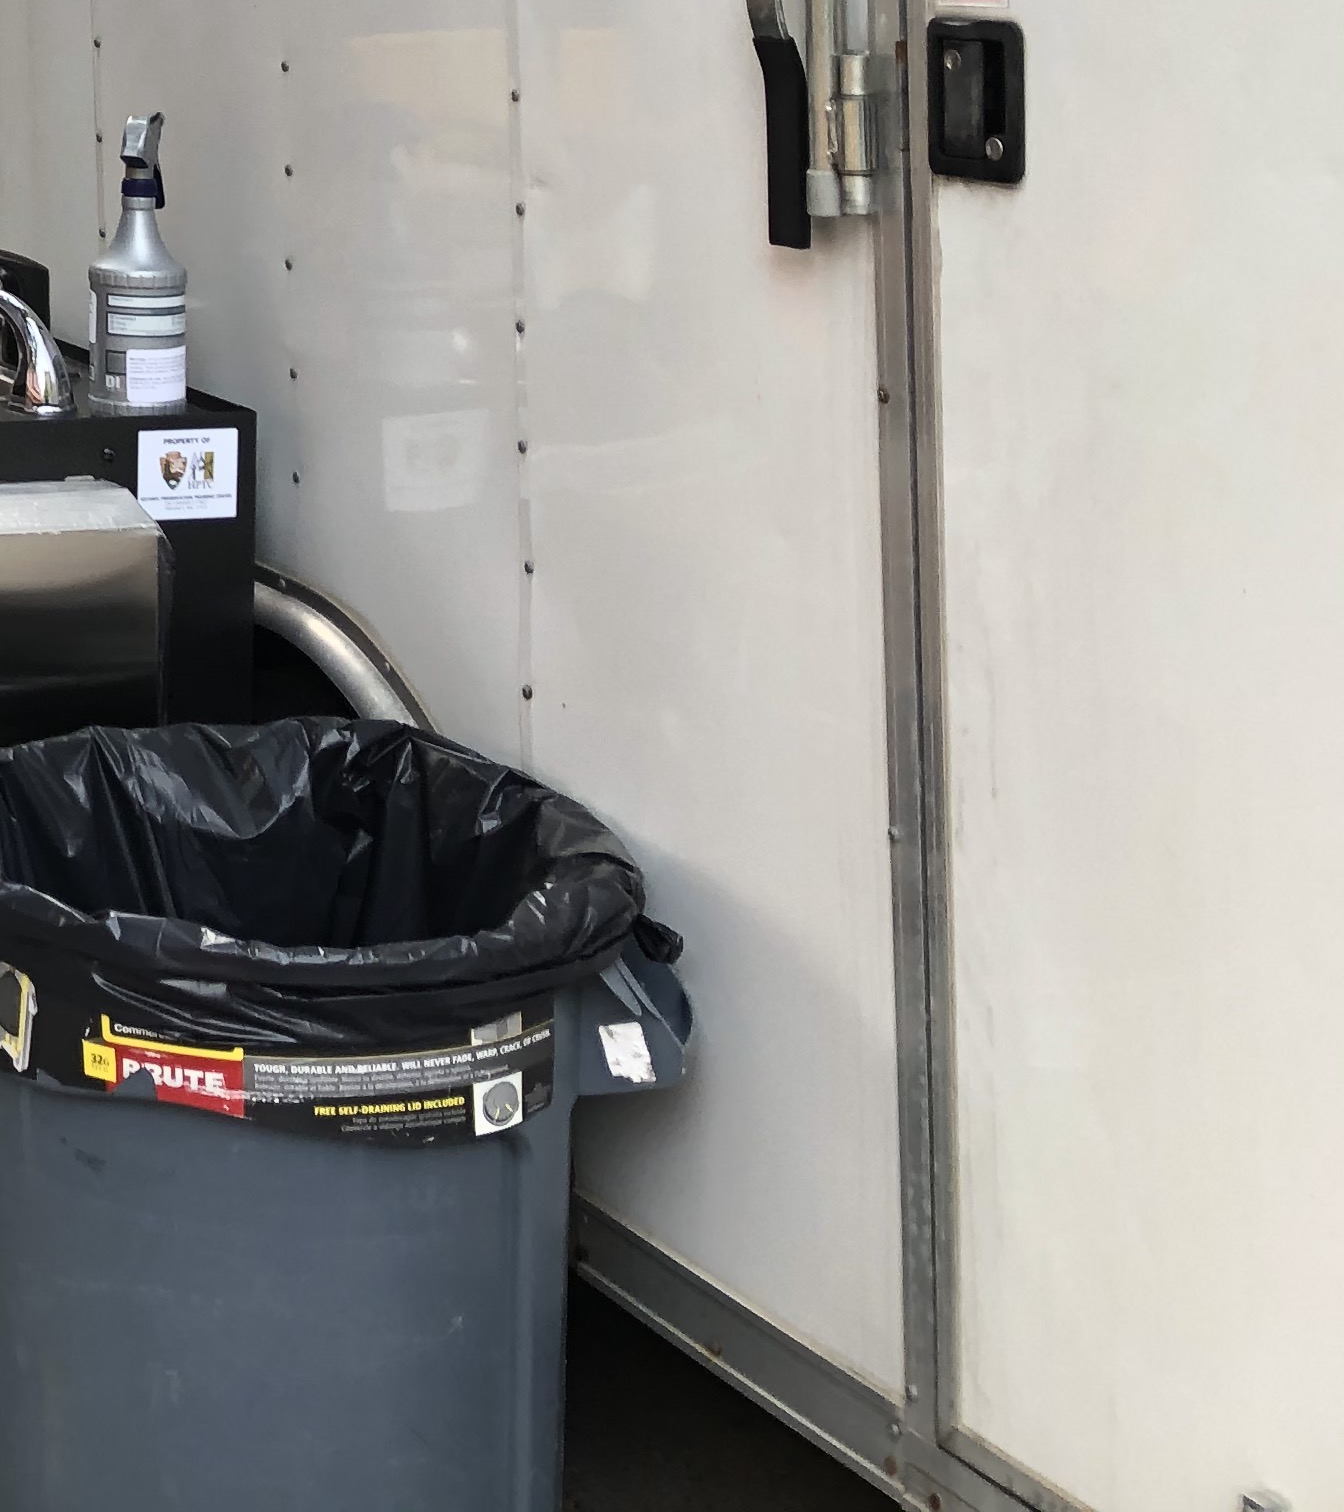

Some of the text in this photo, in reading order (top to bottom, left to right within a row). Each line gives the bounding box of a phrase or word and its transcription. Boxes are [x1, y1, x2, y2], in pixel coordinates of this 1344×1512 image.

[254, 1063, 288, 1074] TOUGH,
[290, 1065, 332, 1074] DURABLE
[402, 1061, 420, 1070] WILL
[424, 1057, 450, 1067] NEVER
[476, 1048, 498, 1060] WARP,
[314, 1097, 465, 1116] FREE SELF-DRAINING LID INCLUDED
